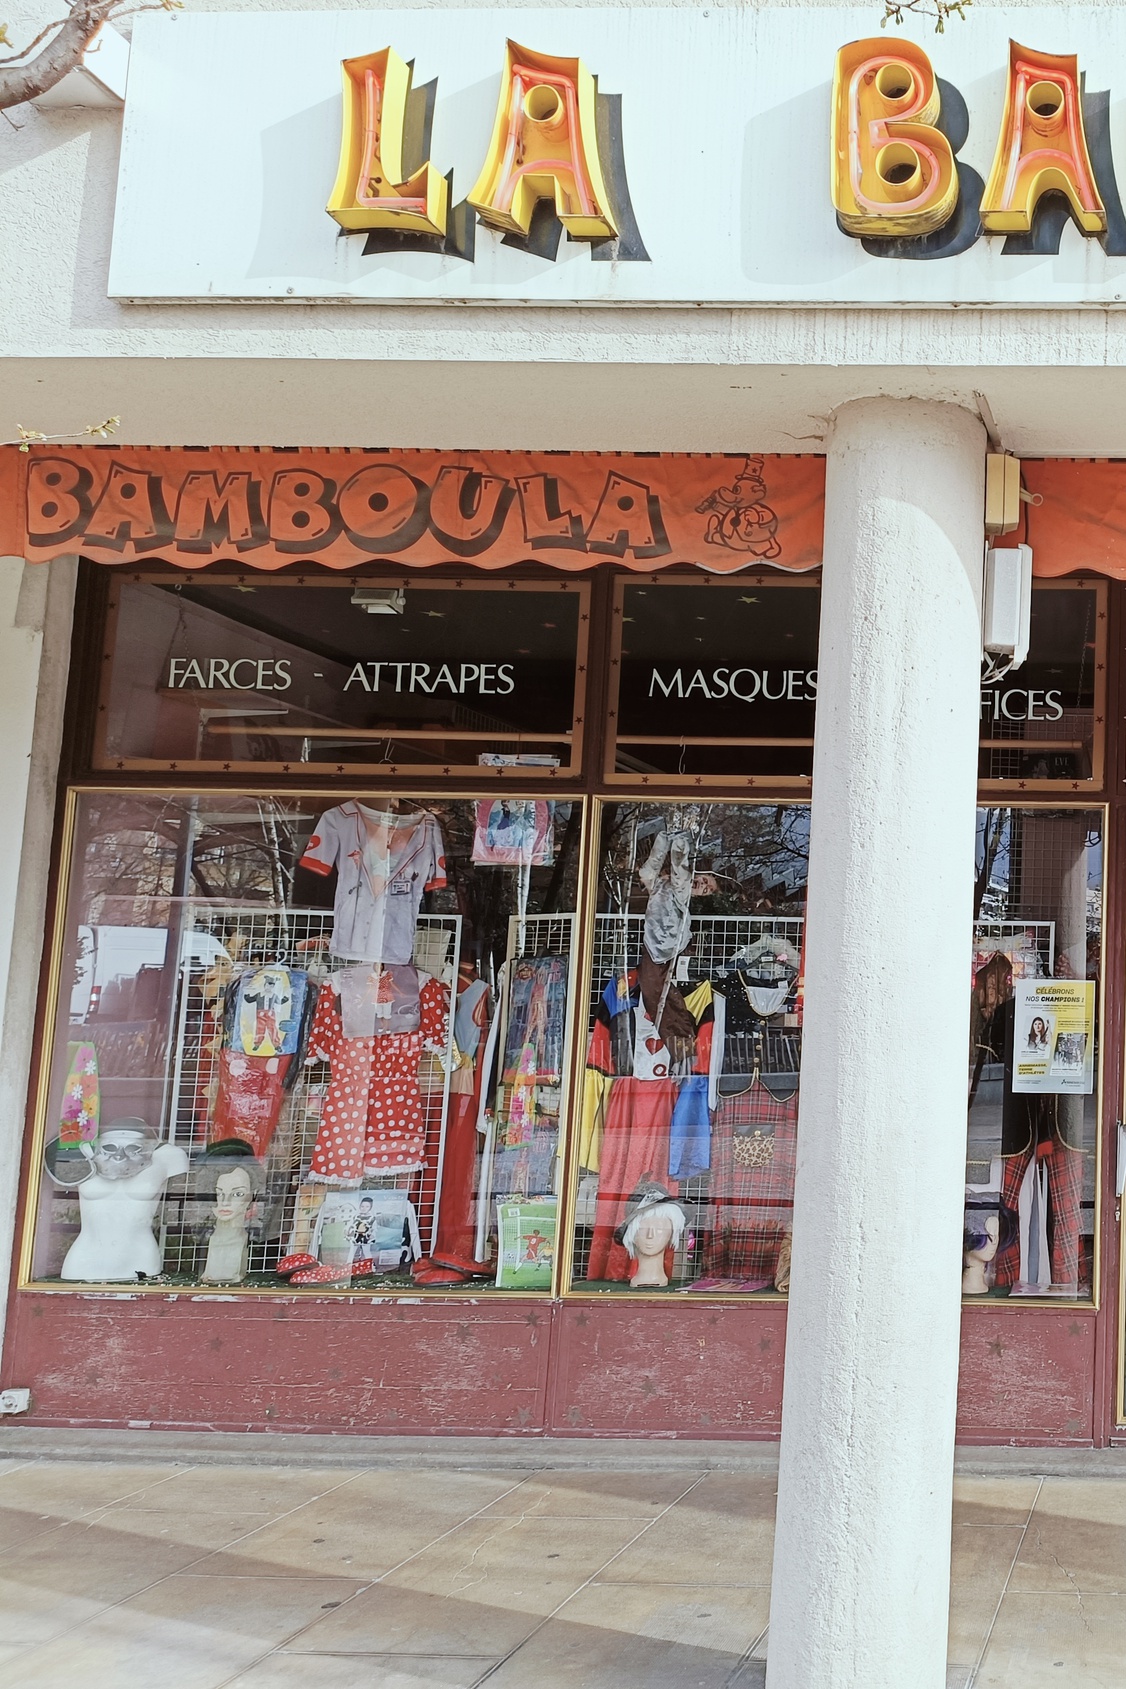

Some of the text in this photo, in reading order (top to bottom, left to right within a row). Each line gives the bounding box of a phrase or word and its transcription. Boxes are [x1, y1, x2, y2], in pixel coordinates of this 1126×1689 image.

[326, 37, 619, 241] LA
[25, 456, 673, 559] BAMBOULA
[167, 658, 293, 693] FARCES
[343, 661, 516, 696] ATTRAPES
[647, 668, 819, 704] MASQUES
[1035, 986, 1075, 995] CÉLÉBRONS
[653, 1064, 667, 1077] Q
